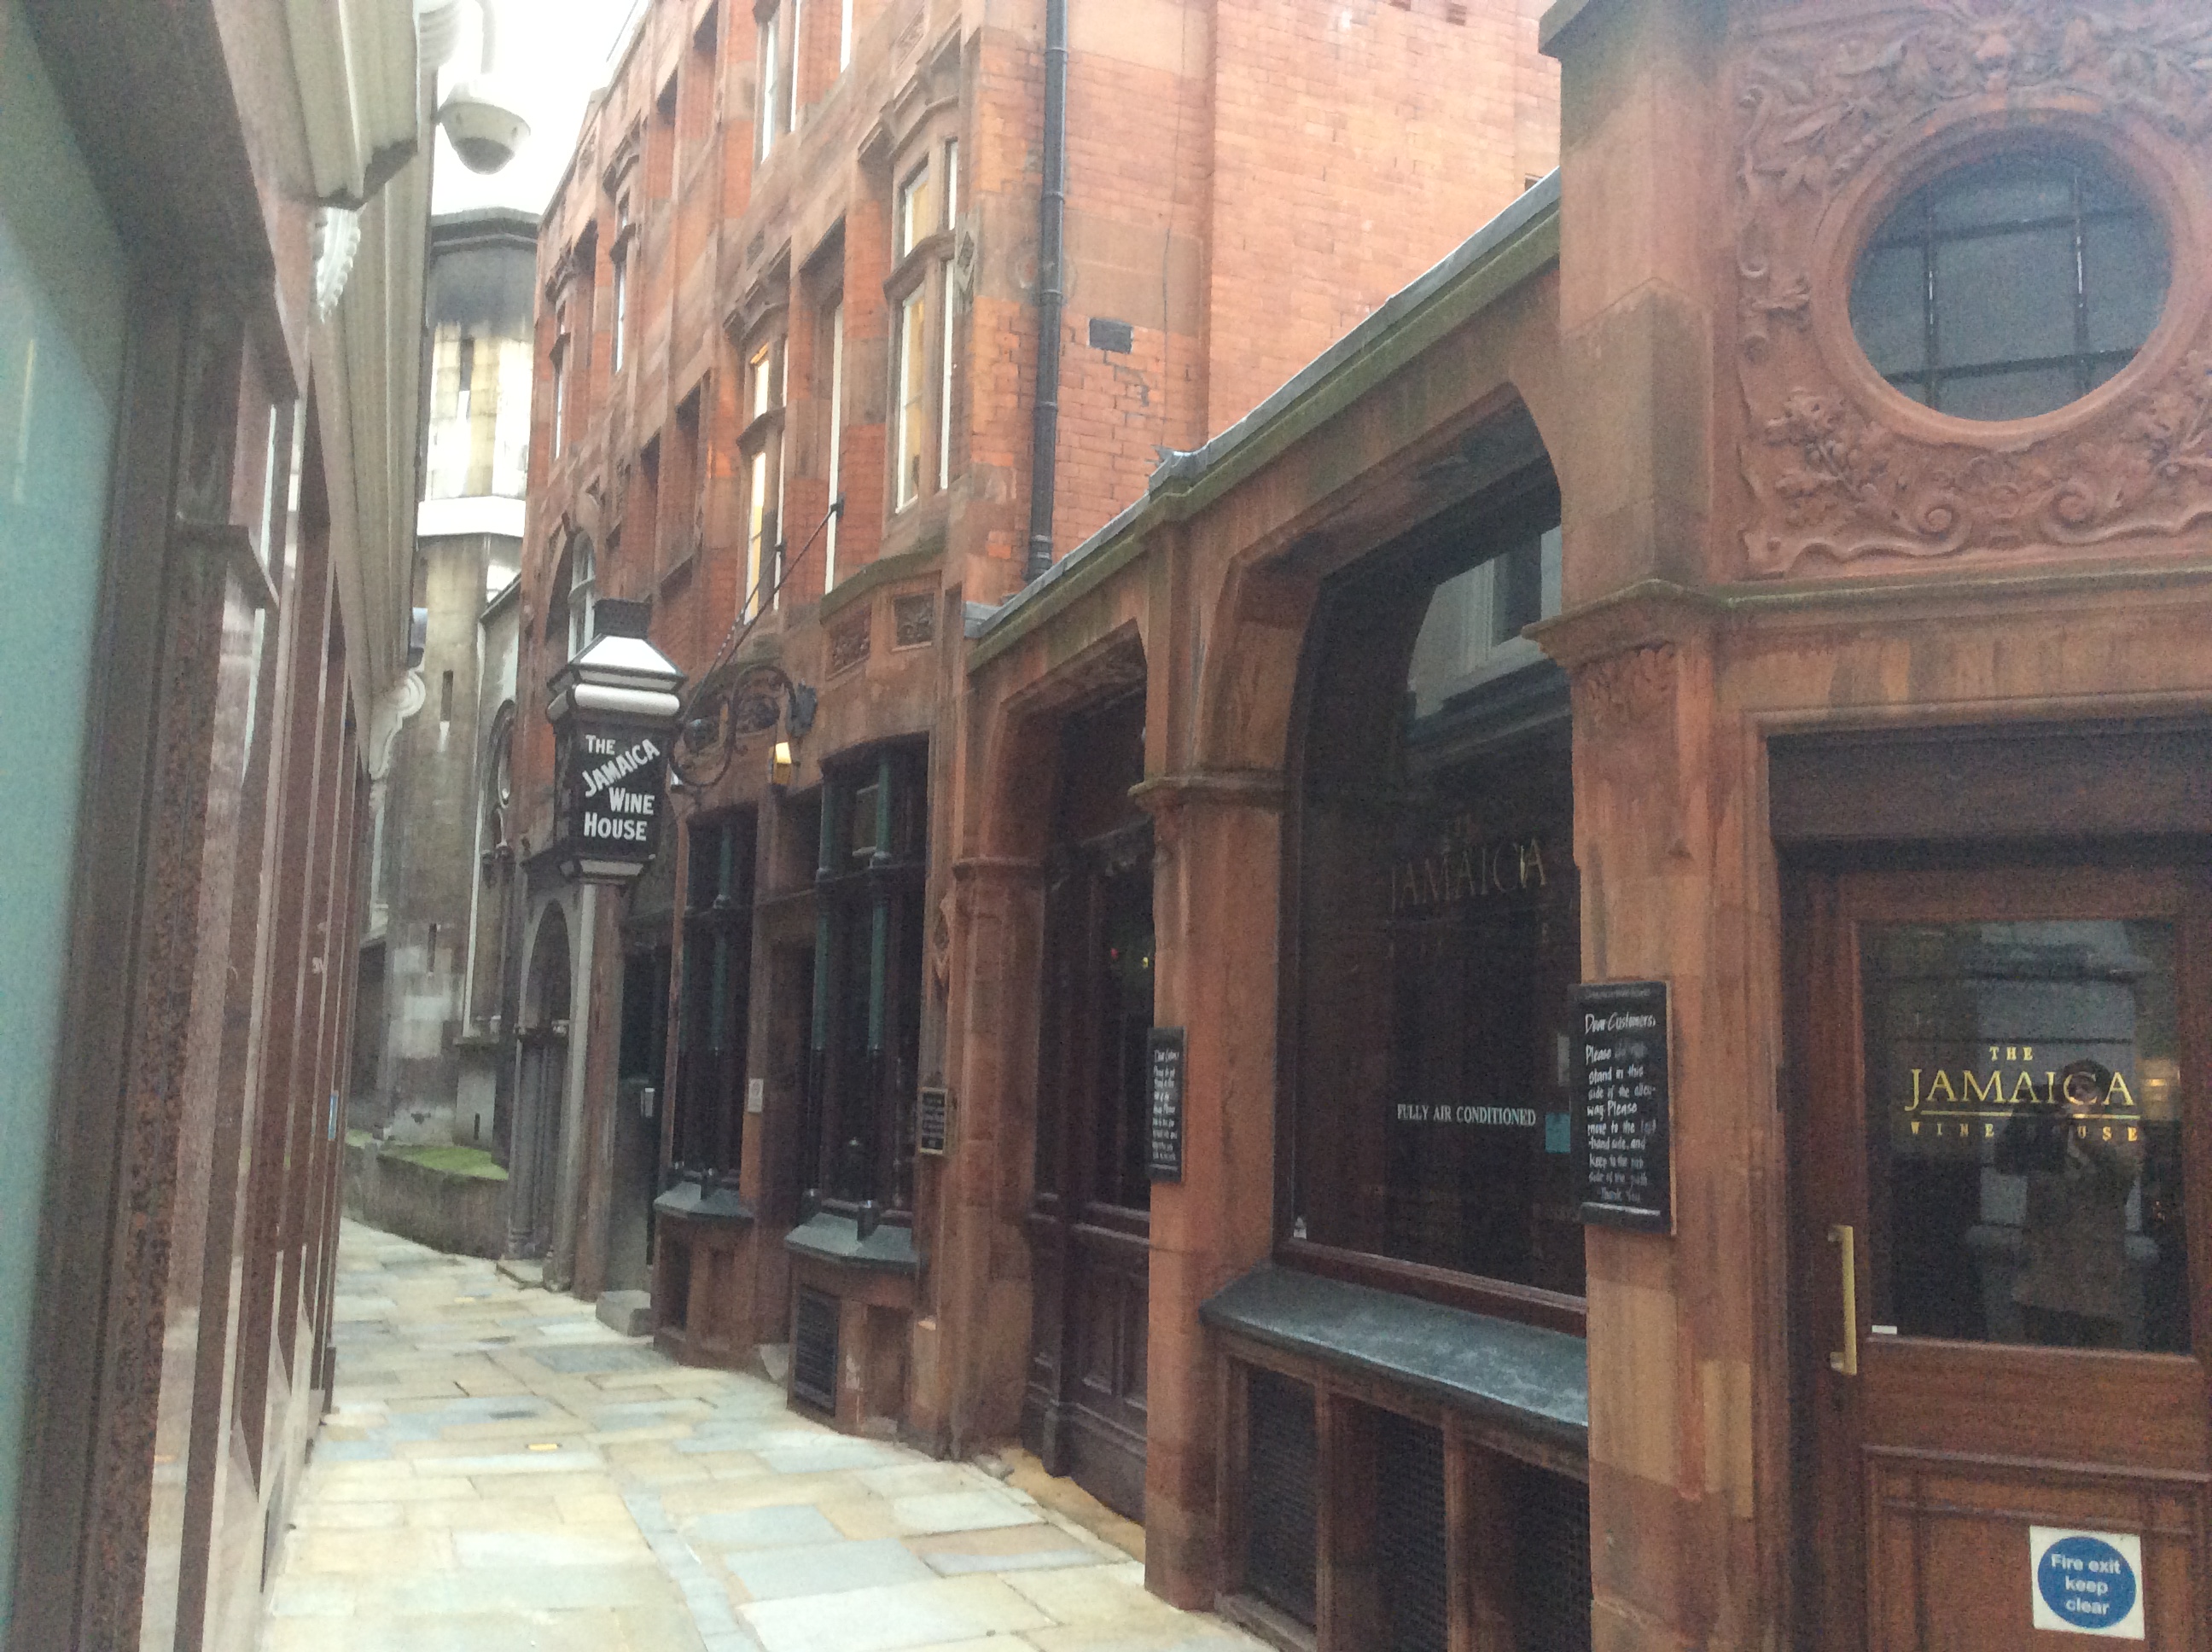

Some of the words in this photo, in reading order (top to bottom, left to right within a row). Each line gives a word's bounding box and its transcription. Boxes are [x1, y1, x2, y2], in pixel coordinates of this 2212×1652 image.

[585, 735, 615, 755] THE
[582, 738, 661, 798] JAMAICA
[608, 787, 655, 815] WINE
[584, 811, 648, 841] HOUSE
[1585, 1013, 1606, 1035] Dear
[1586, 1044, 1612, 1065] Please
[1989, 1046, 2034, 1062] THE
[1588, 1066, 1612, 1085] stand
[1615, 1067, 1624, 1079] in
[1627, 1063, 1644, 1078] this
[1588, 1085, 1604, 1101] side
[1618, 1084, 1630, 1098] the
[1905, 1068, 2134, 1112] JAMAICA
[1397, 1103, 1429, 1121] FULLY
[1433, 1105, 1452, 1122] AIR
[1456, 1106, 1536, 1126] CONDITIONED
[1607, 1100, 1638, 1116] Please
[1587, 1122, 1607, 1137] move
[1610, 1119, 1619, 1134] to
[1622, 1119, 1635, 1134] the
[1911, 1121, 1994, 1138] WINE
[2027, 1125, 2139, 1142] USE
[1630, 1134, 1646, 1150] and
[2051, 1553, 2083, 1572] Fire
[2088, 1556, 2121, 1574] exit
[2065, 1576, 2109, 1597] keep
[2065, 1597, 2110, 1615] clear
